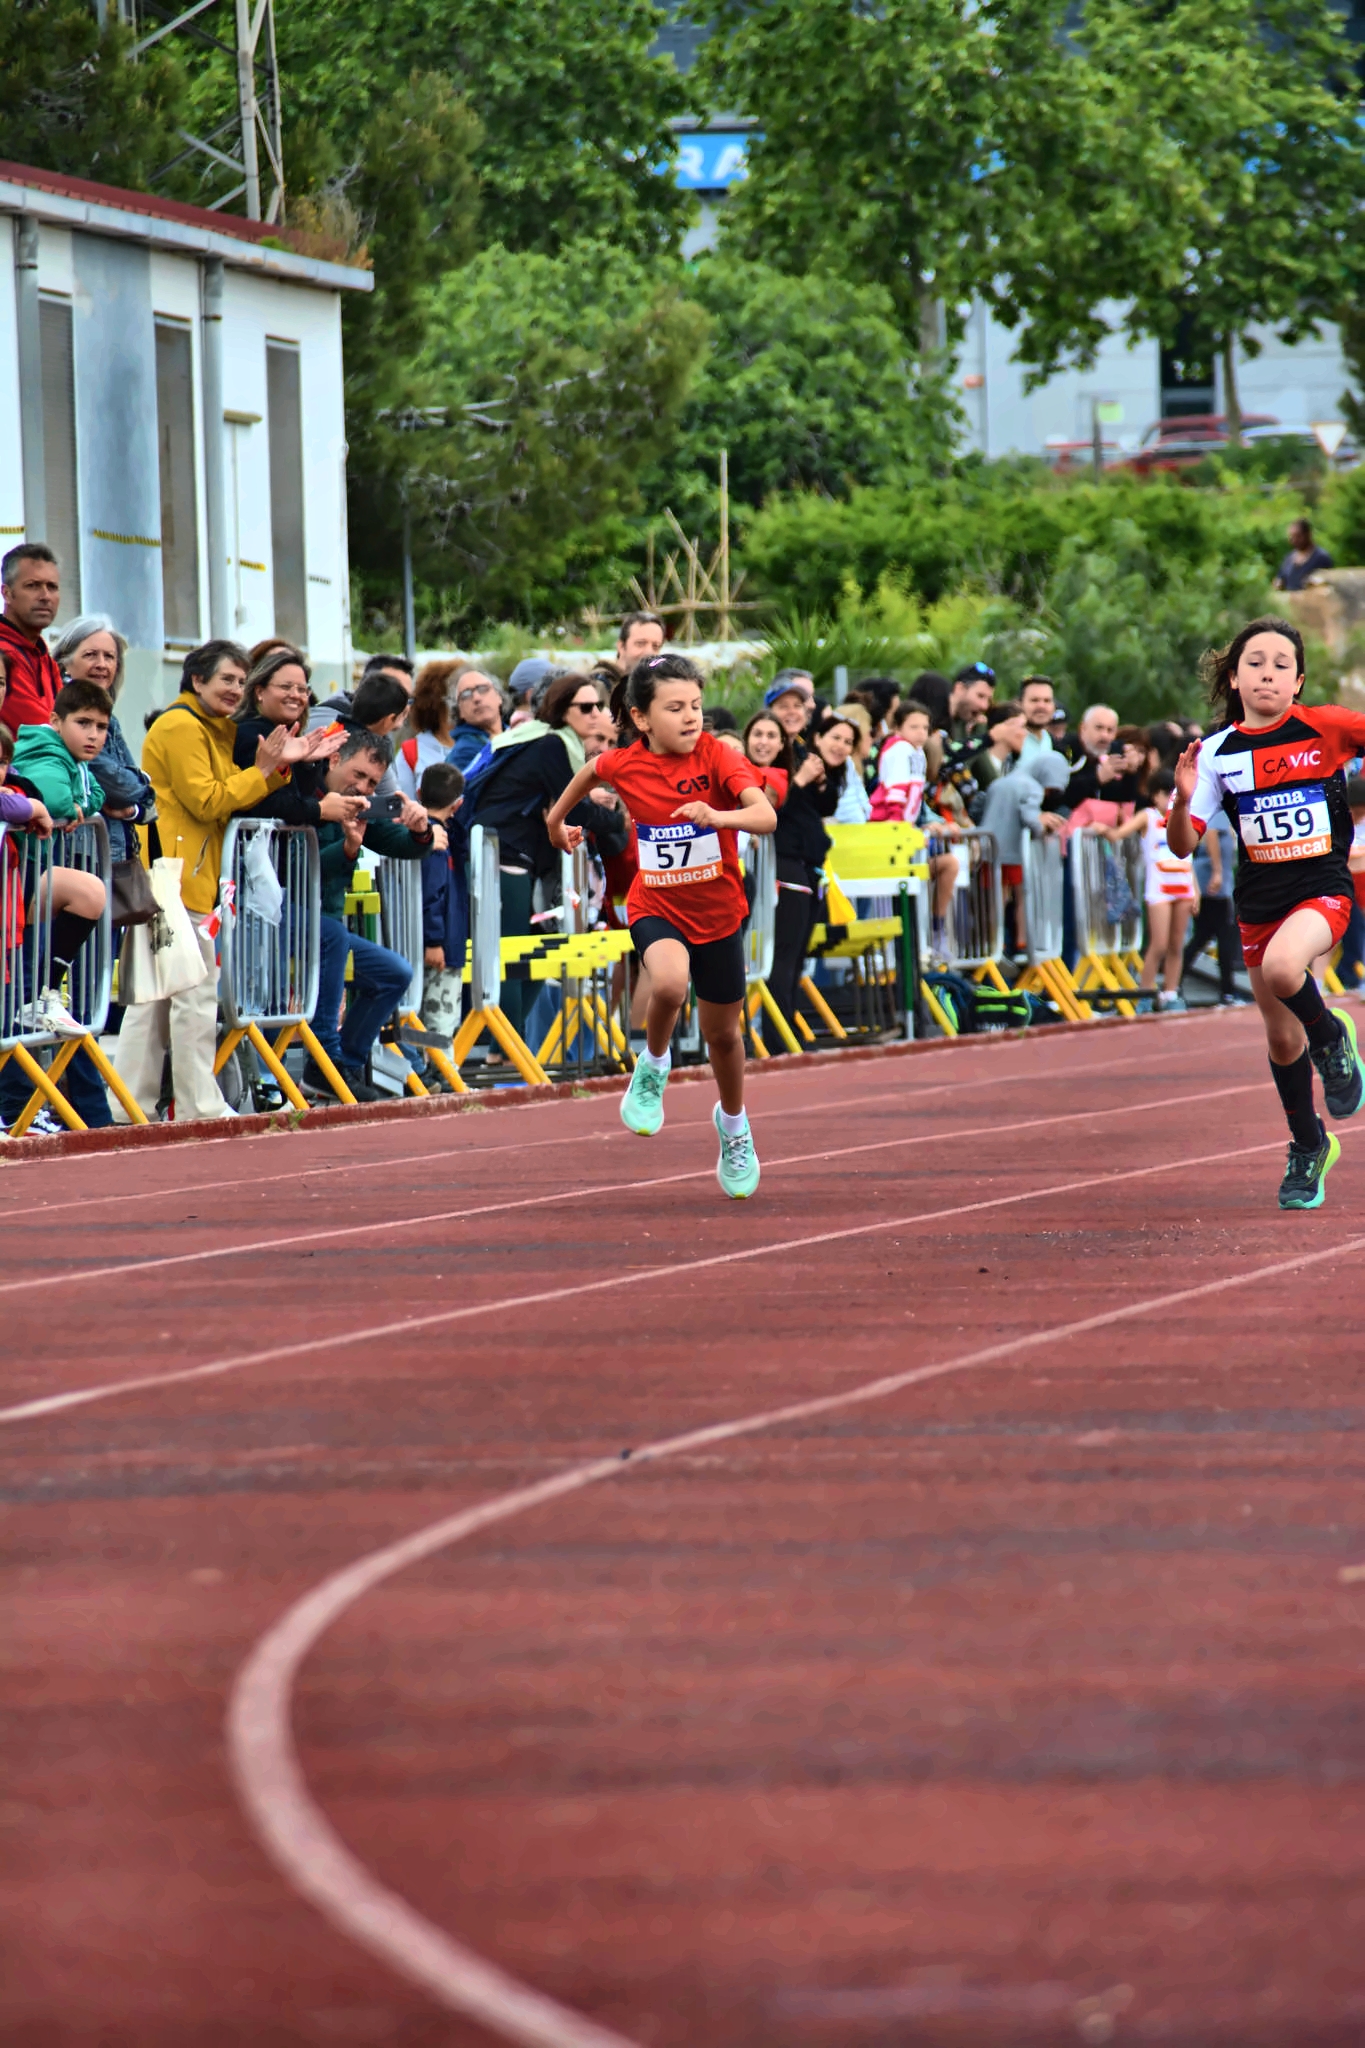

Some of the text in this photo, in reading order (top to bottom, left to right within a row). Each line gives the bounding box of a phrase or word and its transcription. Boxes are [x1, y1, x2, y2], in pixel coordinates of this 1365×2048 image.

[1263, 750, 1321, 774] CAVIC
[1254, 807, 1315, 844] 159
[656, 841, 692, 869] 57
[1253, 837, 1328, 860] mutuacat
[644, 864, 718, 886] mutuacat
